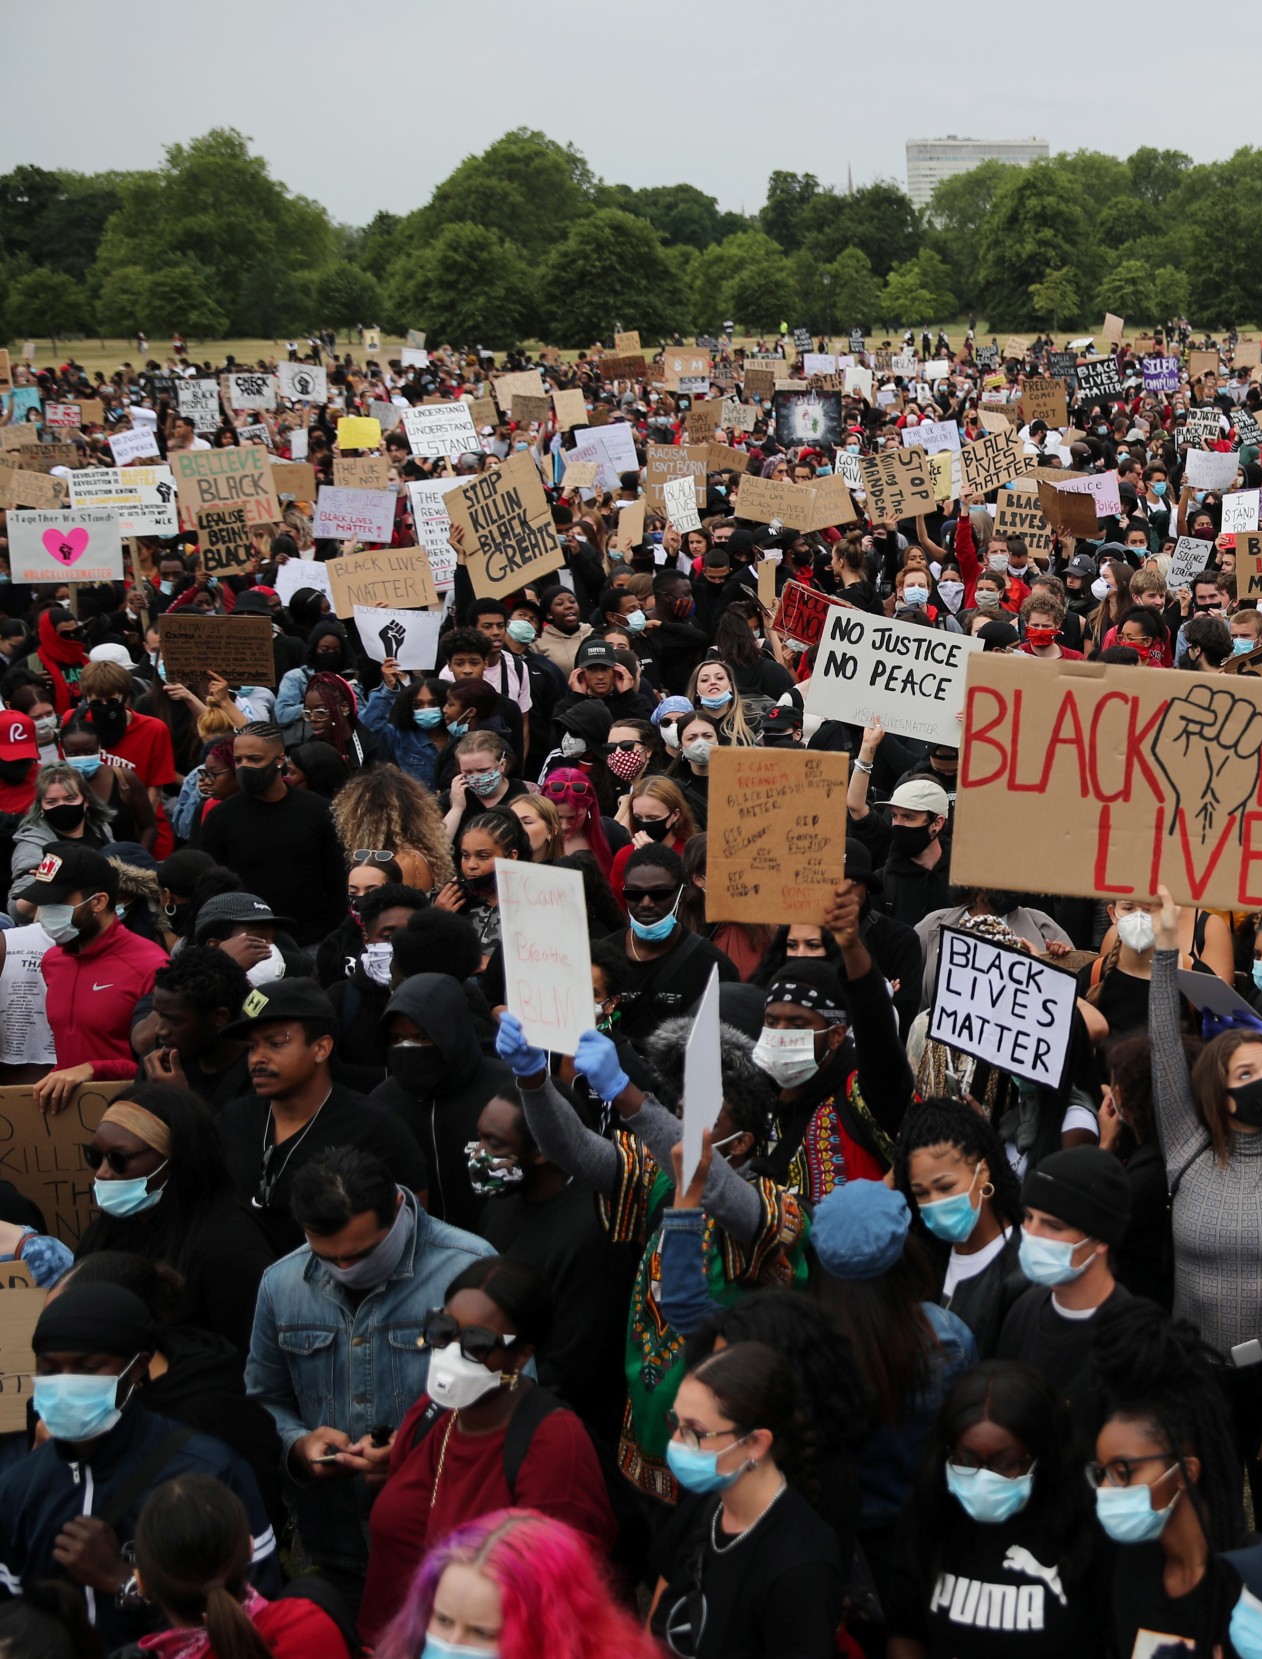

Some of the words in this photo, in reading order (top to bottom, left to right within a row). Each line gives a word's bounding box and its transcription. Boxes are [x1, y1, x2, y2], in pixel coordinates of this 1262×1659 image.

[1077, 360, 1118, 378] BLACK
[1022, 379, 1062, 393] FREEDOM
[1078, 383, 1122, 400] MATTER
[1081, 373, 1120, 389] LIVES
[1029, 392, 1056, 400] COMES
[691, 413, 709, 422] SAY
[1032, 410, 1057, 420] COST
[408, 420, 473, 436] UNDERSTAND
[1176, 426, 1200, 437] BLACK
[649, 447, 688, 461] RACISM
[960, 427, 1019, 469] BLACK
[181, 449, 263, 478] BELIEVE
[965, 446, 1018, 484] LIVES
[967, 455, 1037, 494] MATTER
[897, 450, 930, 500] STOP
[198, 473, 268, 503] BLACK
[418, 492, 440, 504] THE
[463, 471, 502, 510] STOP
[666, 484, 695, 503] BLACK
[199, 508, 245, 530] LEGALISE
[319, 511, 348, 522] BLACK
[350, 513, 374, 525] LIVES
[469, 487, 523, 534] KILLIN
[669, 499, 697, 519] LIVES
[1224, 506, 1256, 523] STAND
[336, 523, 374, 535] MATTER
[998, 510, 1047, 531] LIVES
[1232, 521, 1250, 533] FOR
[207, 526, 250, 547] BEING
[478, 508, 533, 556] BLACK
[203, 543, 255, 572] BLACK
[486, 521, 559, 583] GREATS
[1175, 550, 1206, 564] SILENCE
[23, 568, 113, 580] #BLACKLIVESMATTER
[334, 560, 384, 578] BLACK
[389, 556, 427, 572] LIVES
[357, 604, 383, 615] BLACK
[385, 605, 408, 616] LIVES
[829, 615, 865, 646] NO
[871, 627, 963, 669] JUSTICE
[823, 649, 859, 681] NO
[869, 659, 953, 701] PEACE
[851, 707, 943, 736] #BLACKLIVESMATTER
[961, 685, 1172, 804] BLACK
[514, 931, 572, 968] Breathe
[949, 936, 1045, 994] BLACK
[516, 979, 578, 1033] BLM
[946, 971, 1058, 1028] LIVES
[936, 1005, 1050, 1073] MATTER
[930, 1575, 1044, 1633] PUMA
